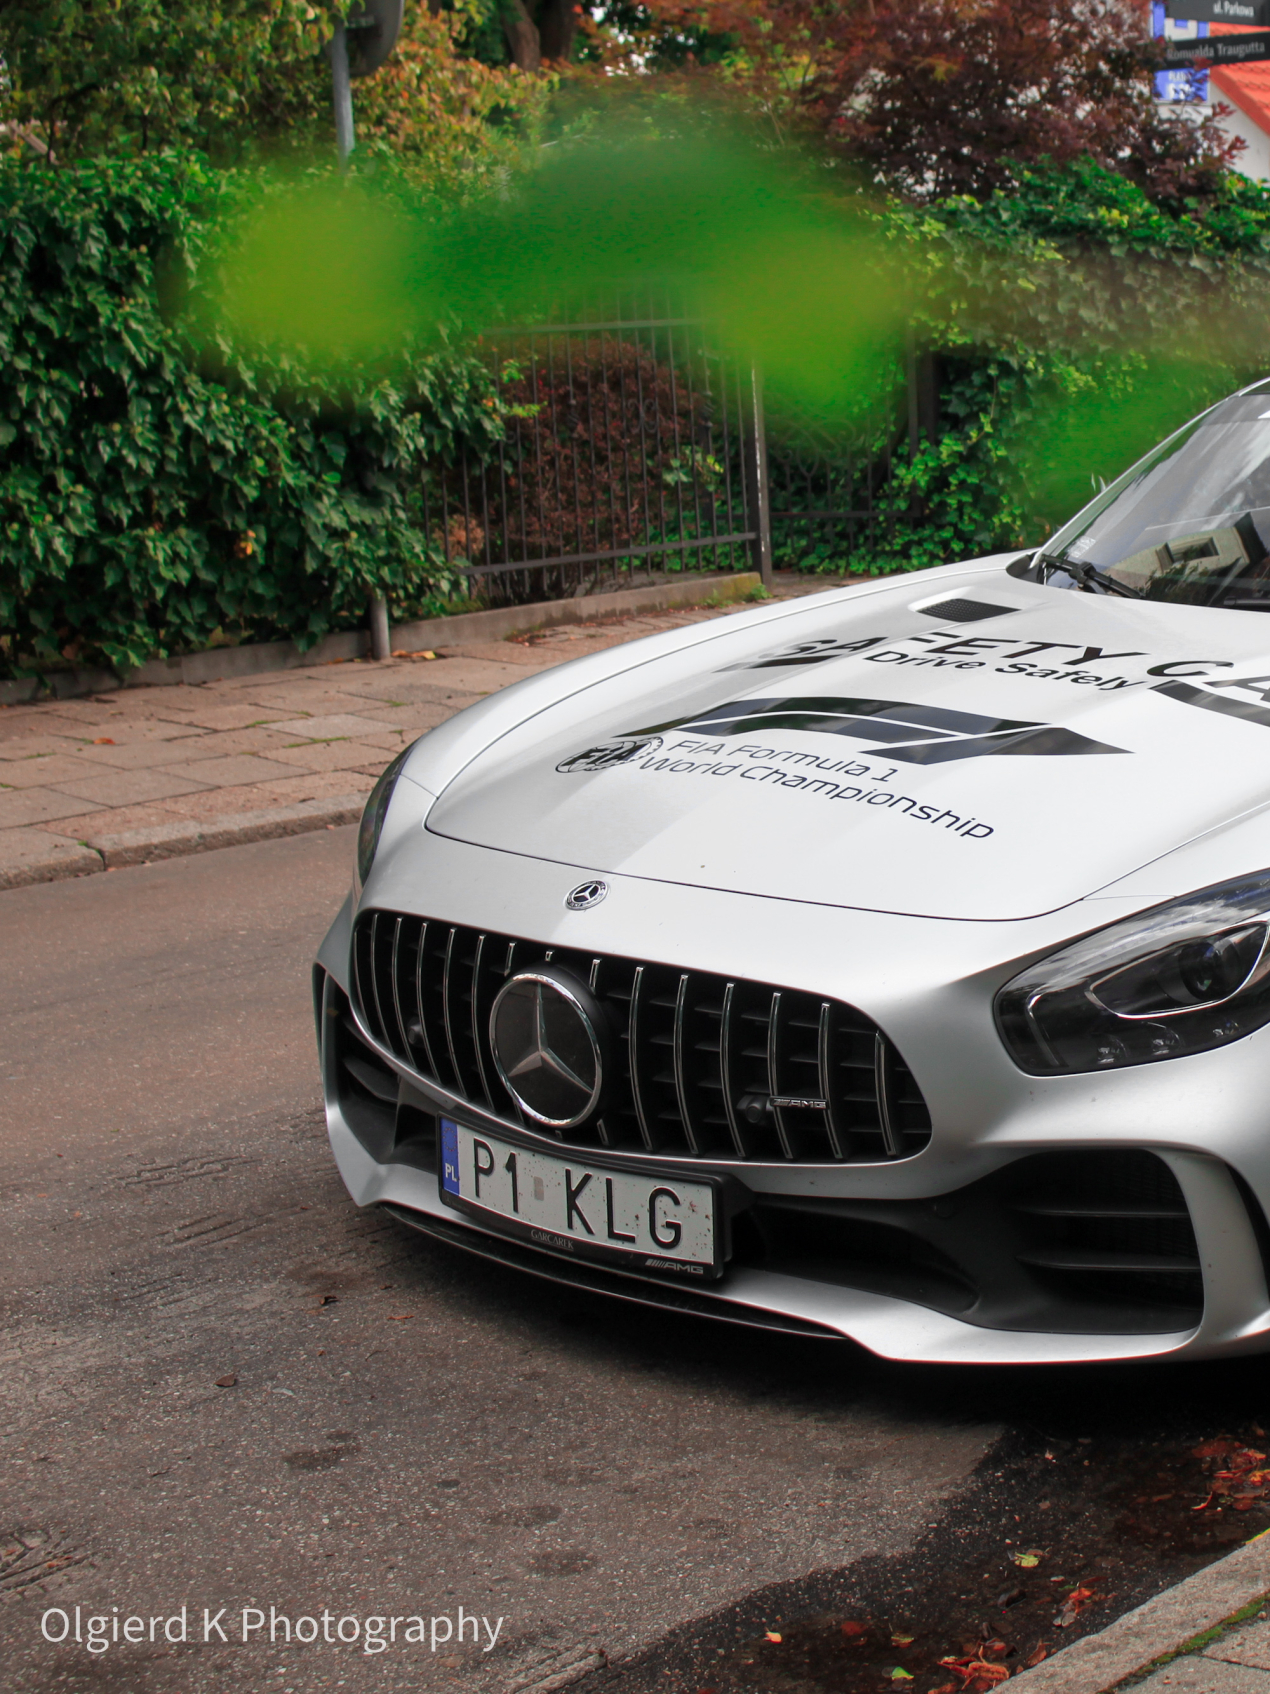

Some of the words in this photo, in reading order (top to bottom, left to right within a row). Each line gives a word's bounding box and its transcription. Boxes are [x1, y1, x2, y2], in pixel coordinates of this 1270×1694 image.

[1217, 42, 1265, 58] Traugutta
[758, 630, 1149, 667] SAFETY
[863, 649, 984, 671] Drive
[993, 661, 1148, 691] Safely
[667, 740, 726, 756] FIA
[733, 744, 871, 777] Formula
[870, 767, 899, 782] 1
[638, 756, 742, 777] World
[739, 765, 995, 839] Championship
[790, 1099, 826, 1109] AMG
[445, 1162, 457, 1183] PL
[472, 1137, 519, 1215] P1
[564, 1167, 682, 1250] KLG
[530, 1229, 574, 1250] GARCAREK
[662, 1260, 704, 1275] AMG
